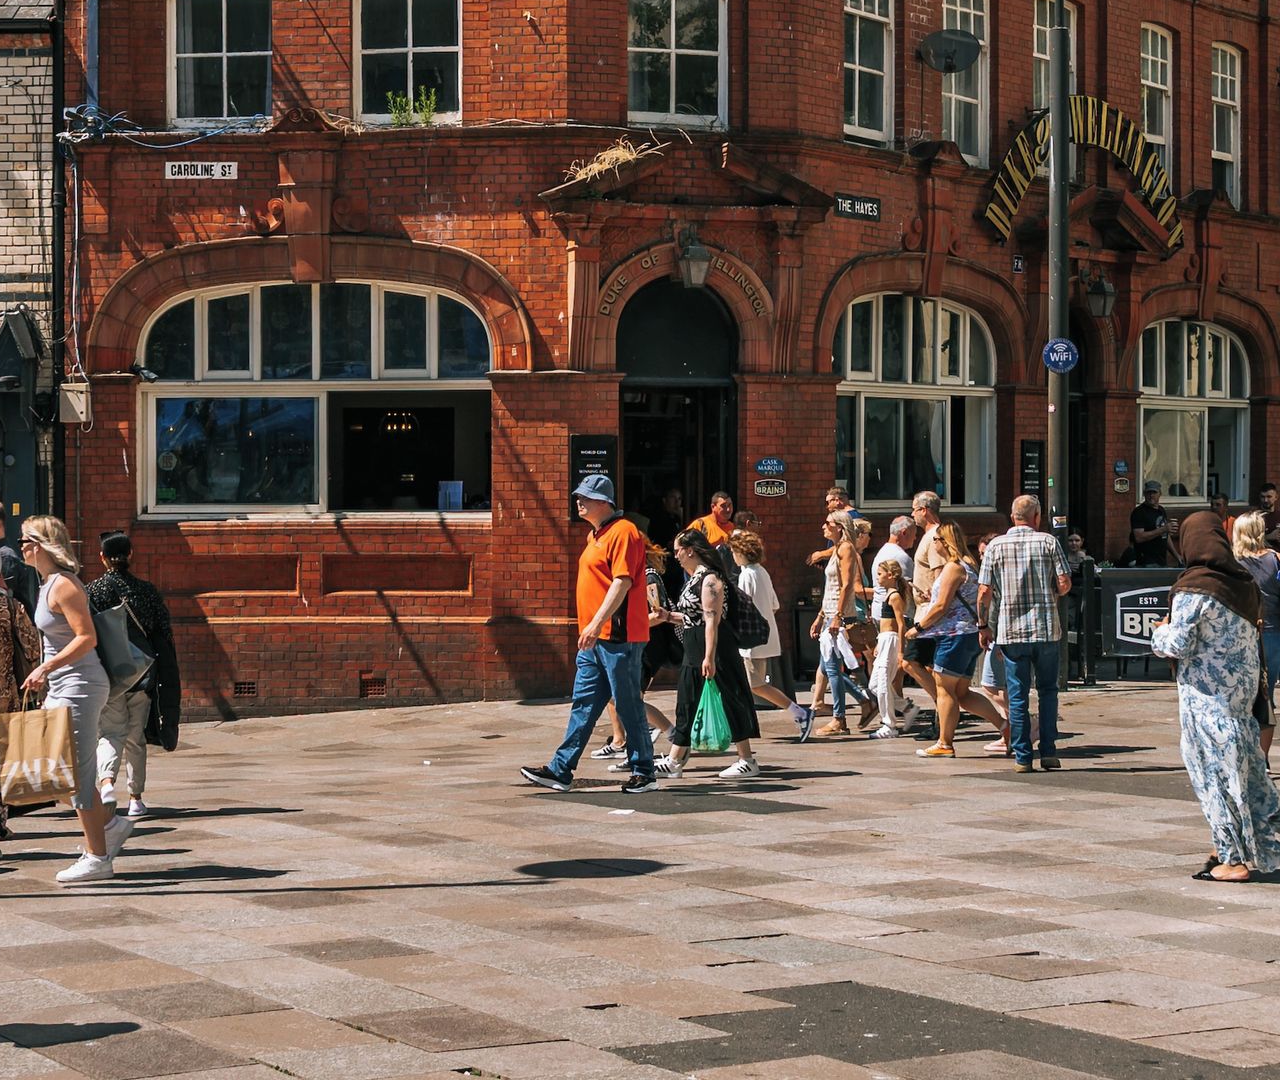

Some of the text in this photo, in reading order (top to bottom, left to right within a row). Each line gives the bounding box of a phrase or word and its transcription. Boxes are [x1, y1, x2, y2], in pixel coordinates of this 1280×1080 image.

[170, 164, 215, 177] CAROLINE
[984, 130, 1037, 241] DUKE
[837, 198, 878, 216] THE HAYES
[599, 274, 628, 316] DUKE
[640, 253, 660, 270] OF
[1050, 351, 1072, 362] WiFi
[756, 486, 784, 495] BRAINS
[0, 754, 76, 804] ZARA
